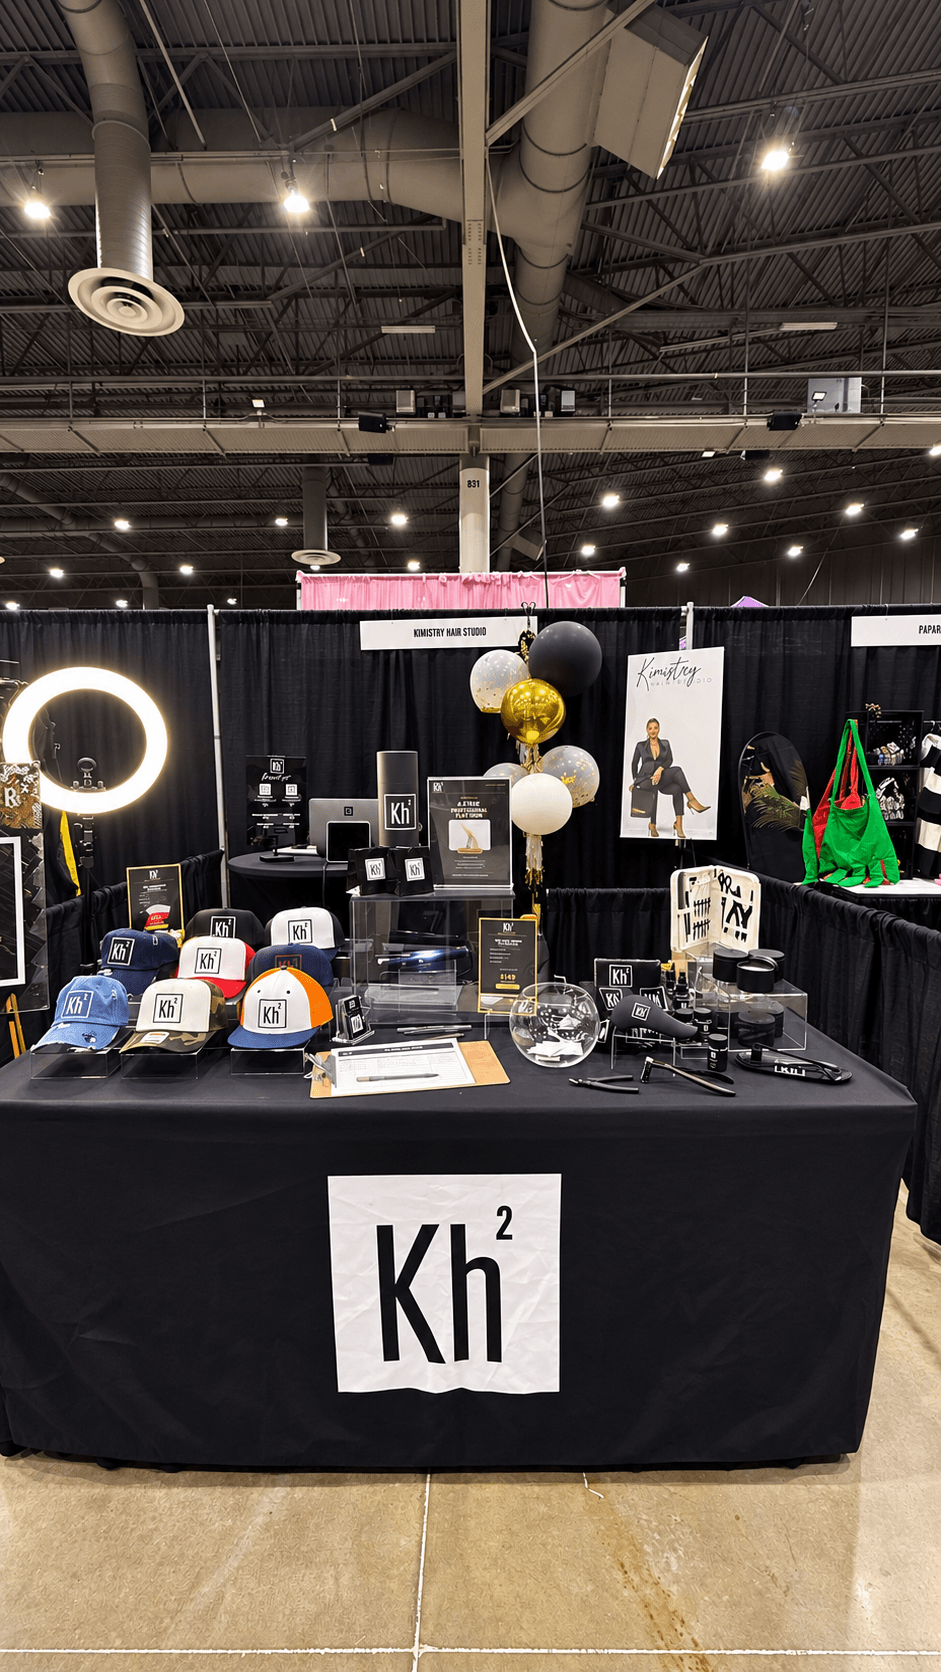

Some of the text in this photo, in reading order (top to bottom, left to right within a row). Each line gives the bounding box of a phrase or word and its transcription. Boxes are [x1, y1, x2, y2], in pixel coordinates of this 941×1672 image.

[467, 480, 480, 488] 831
[413, 627, 487, 638] KIMISTRY HAIR STUDIO
[636, 657, 702, 691] Kimistry
